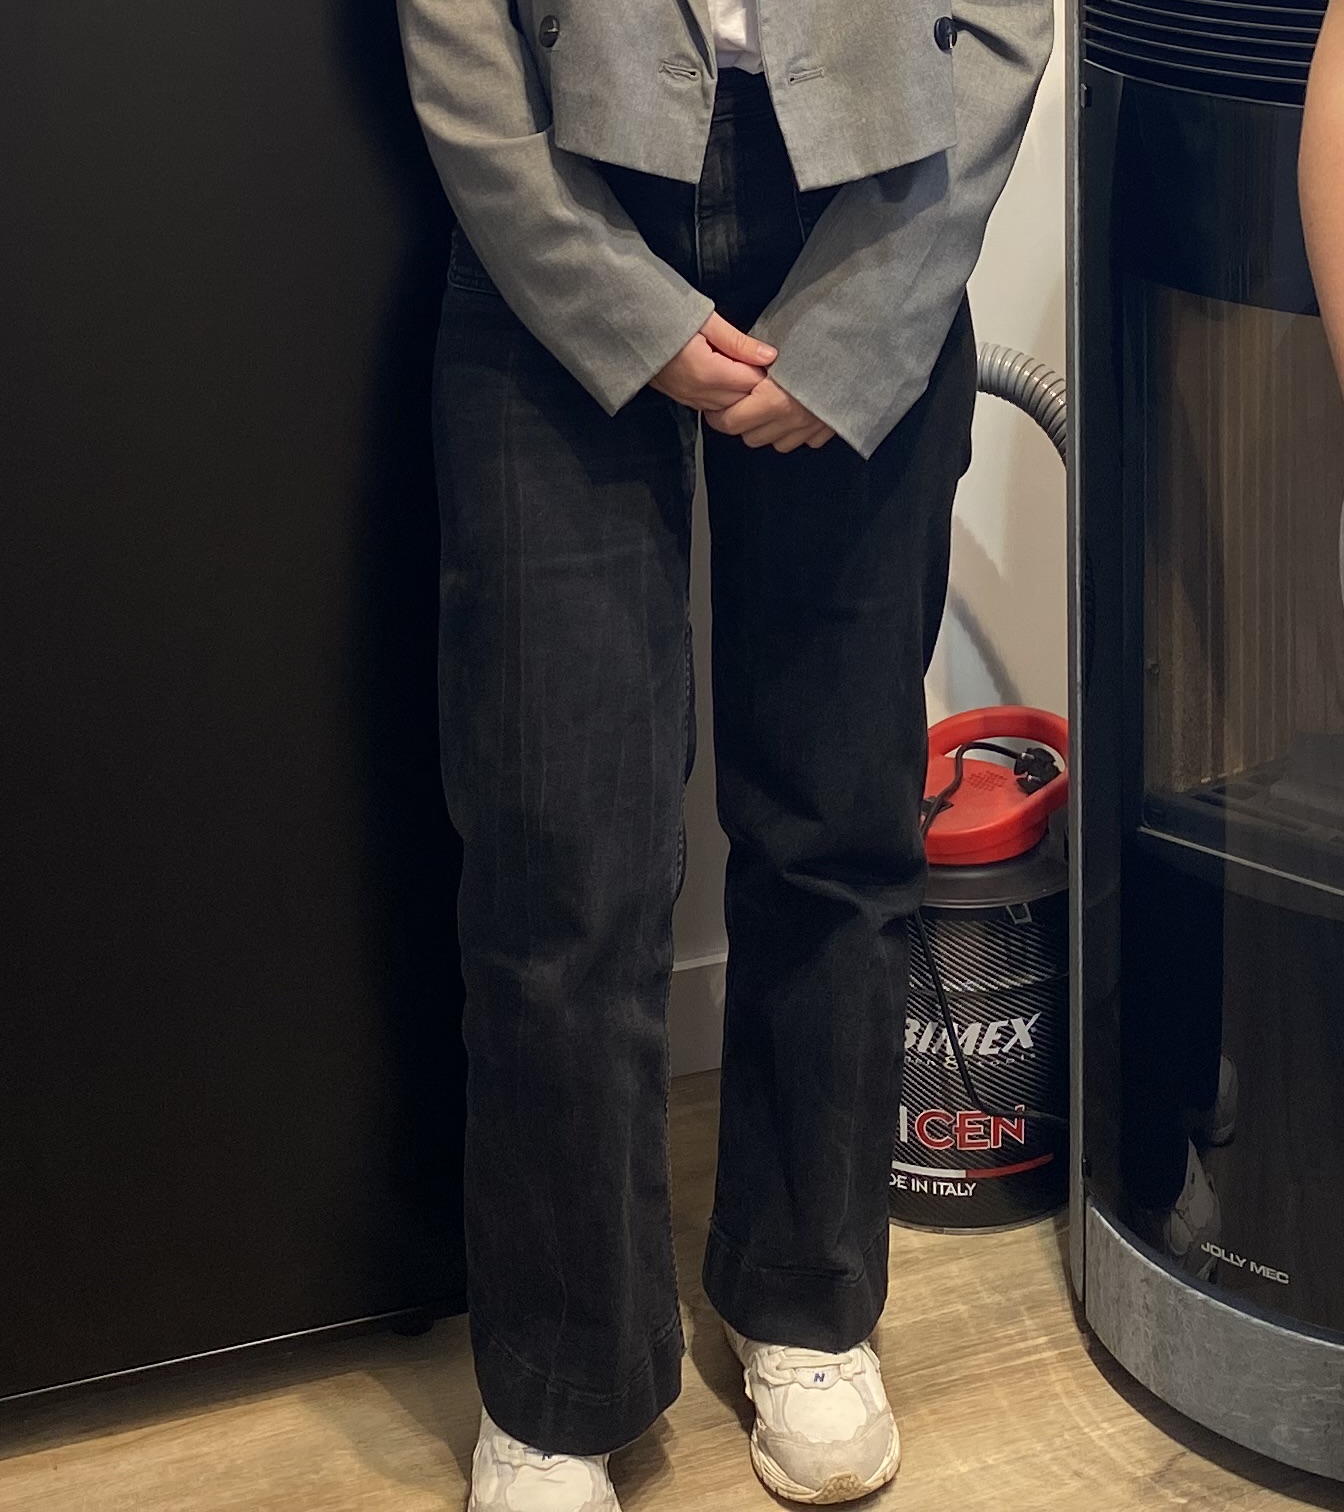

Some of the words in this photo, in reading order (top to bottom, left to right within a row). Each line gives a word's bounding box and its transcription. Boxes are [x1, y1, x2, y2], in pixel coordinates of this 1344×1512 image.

[911, 1178, 928, 1194] IN
[933, 1181, 977, 1196] ITALY
[1200, 1241, 1247, 1268] JOLLY
[1249, 1261, 1290, 1285] MEC
